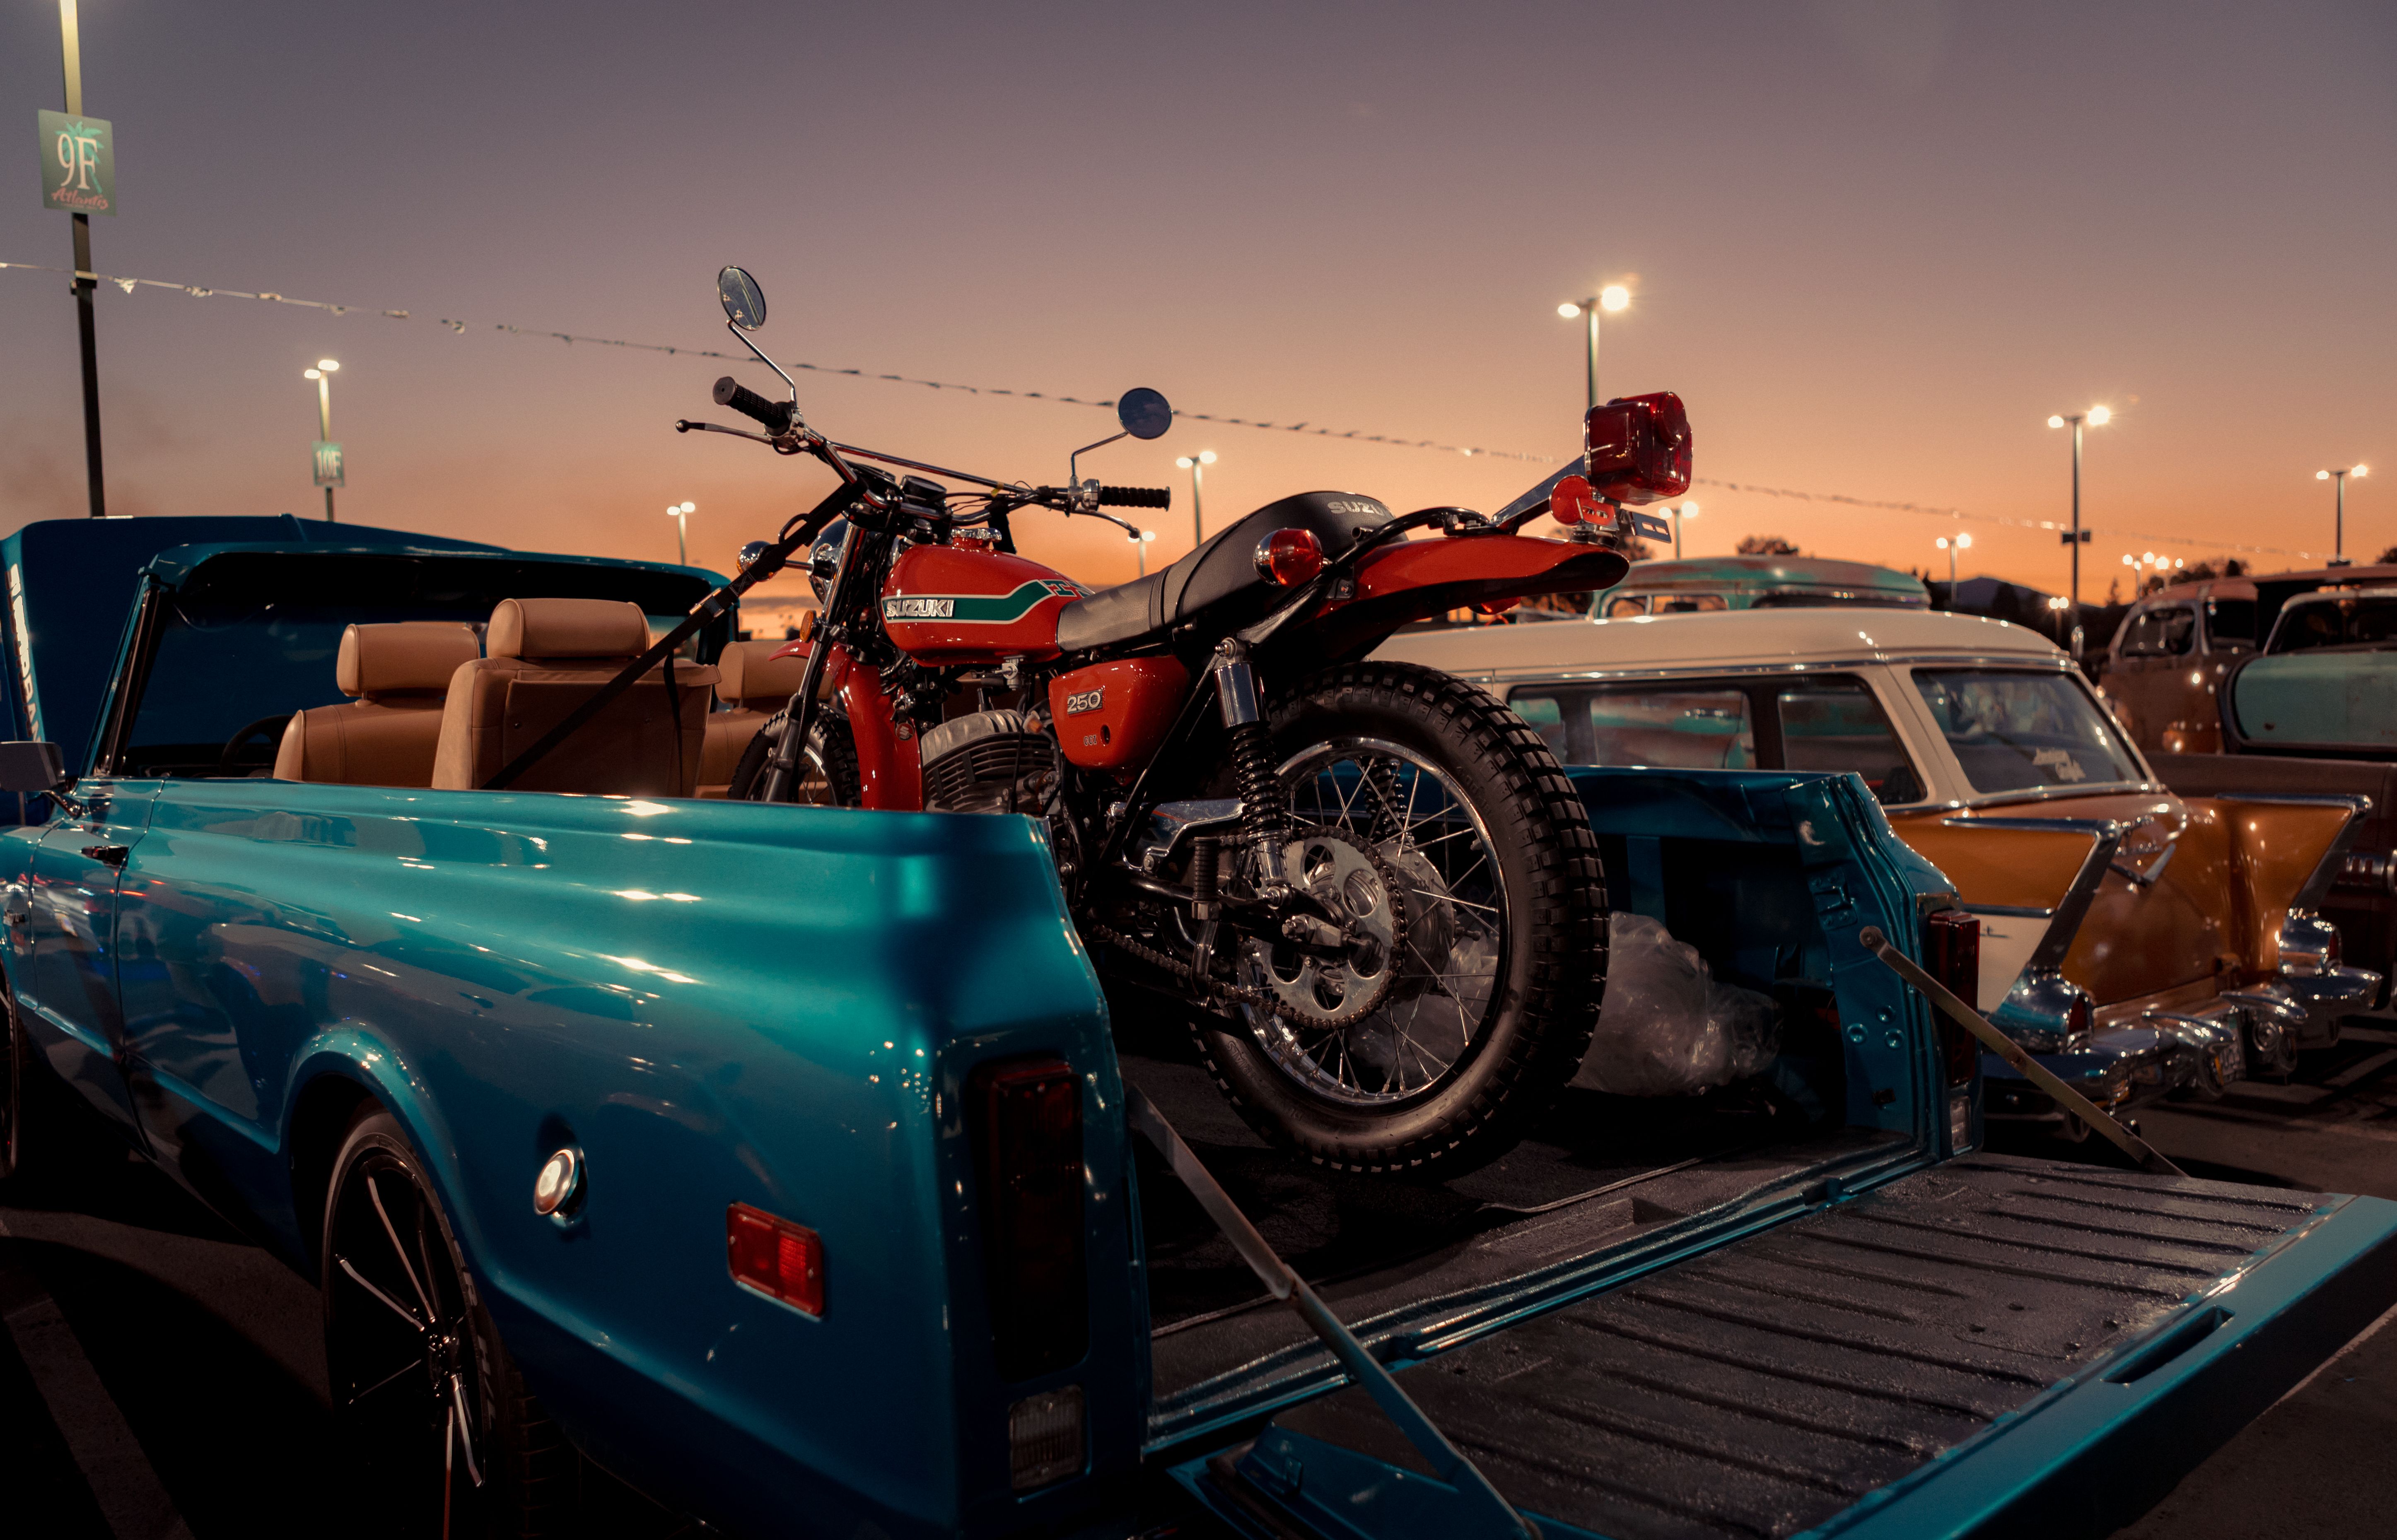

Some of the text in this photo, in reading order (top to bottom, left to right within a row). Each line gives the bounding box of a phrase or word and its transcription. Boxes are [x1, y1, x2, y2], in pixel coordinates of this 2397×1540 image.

[57, 133, 98, 190] 9F
[316, 450, 342, 477] 10F
[886, 599, 955, 618] SUZUKI
[1067, 691, 1101, 713] 250
[1084, 735, 1097, 746] CCI
[1225, 1040, 1255, 1082] TRIALS
